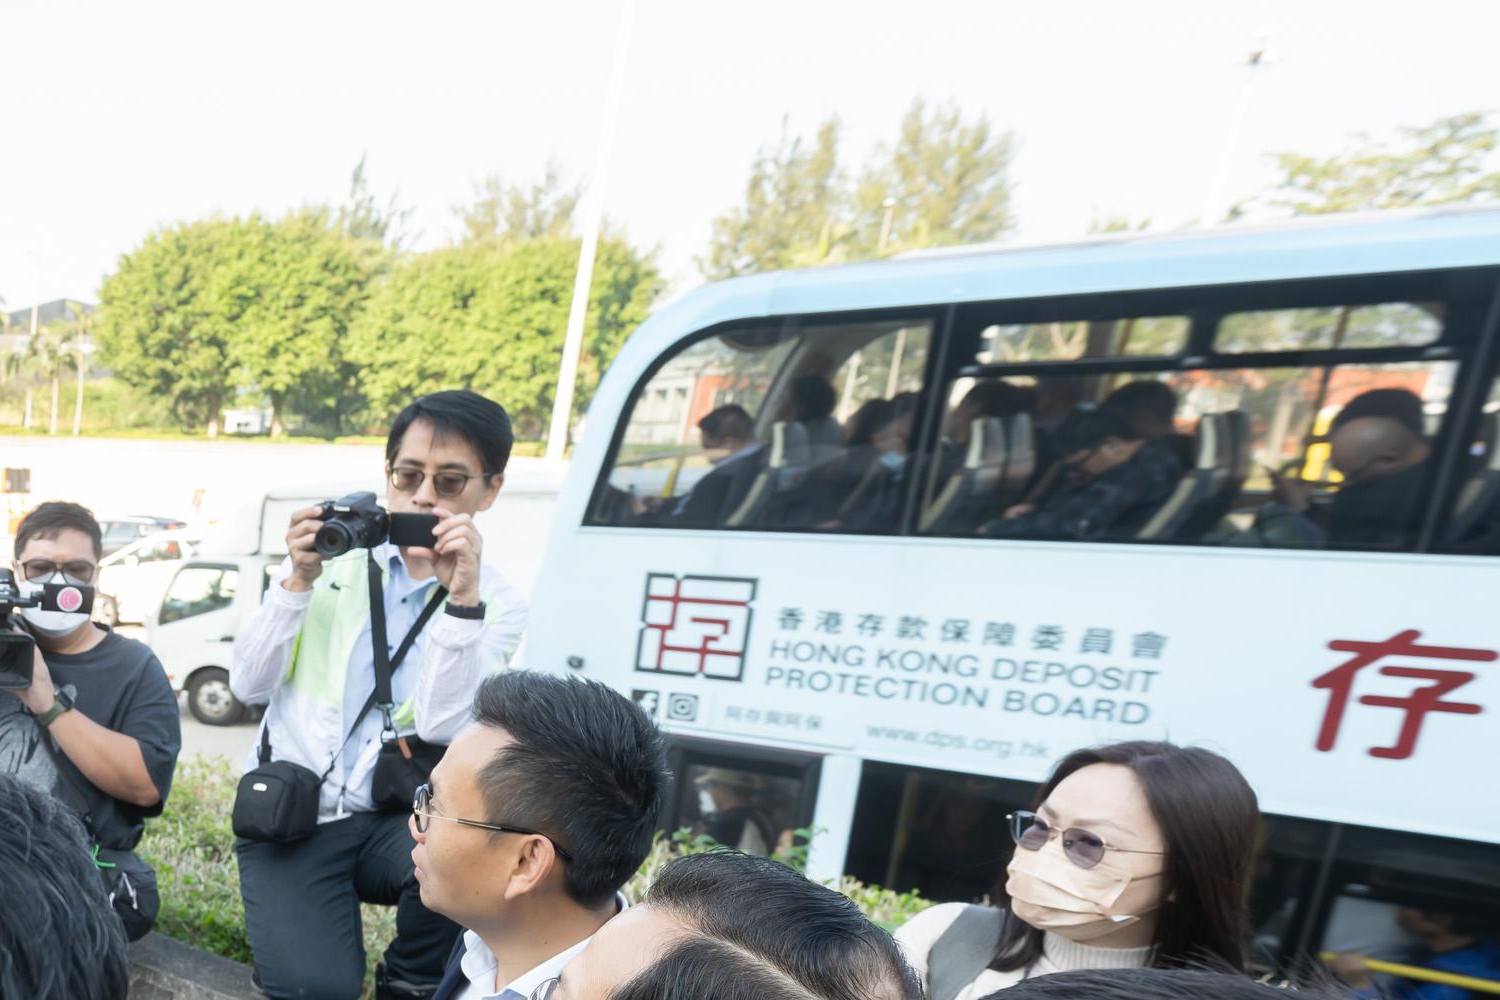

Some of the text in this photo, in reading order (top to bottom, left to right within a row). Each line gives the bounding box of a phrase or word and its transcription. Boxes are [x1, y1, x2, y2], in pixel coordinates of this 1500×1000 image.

[777, 607, 1169, 659] 香港存款保障委員會
[769, 639, 1161, 693] HONG KONG DEPOSIT
[765, 666, 1152, 726] PROTECTION BOARD
[1311, 629, 1499, 760] 存
[866, 724, 1050, 759] www.dps.org.hk
